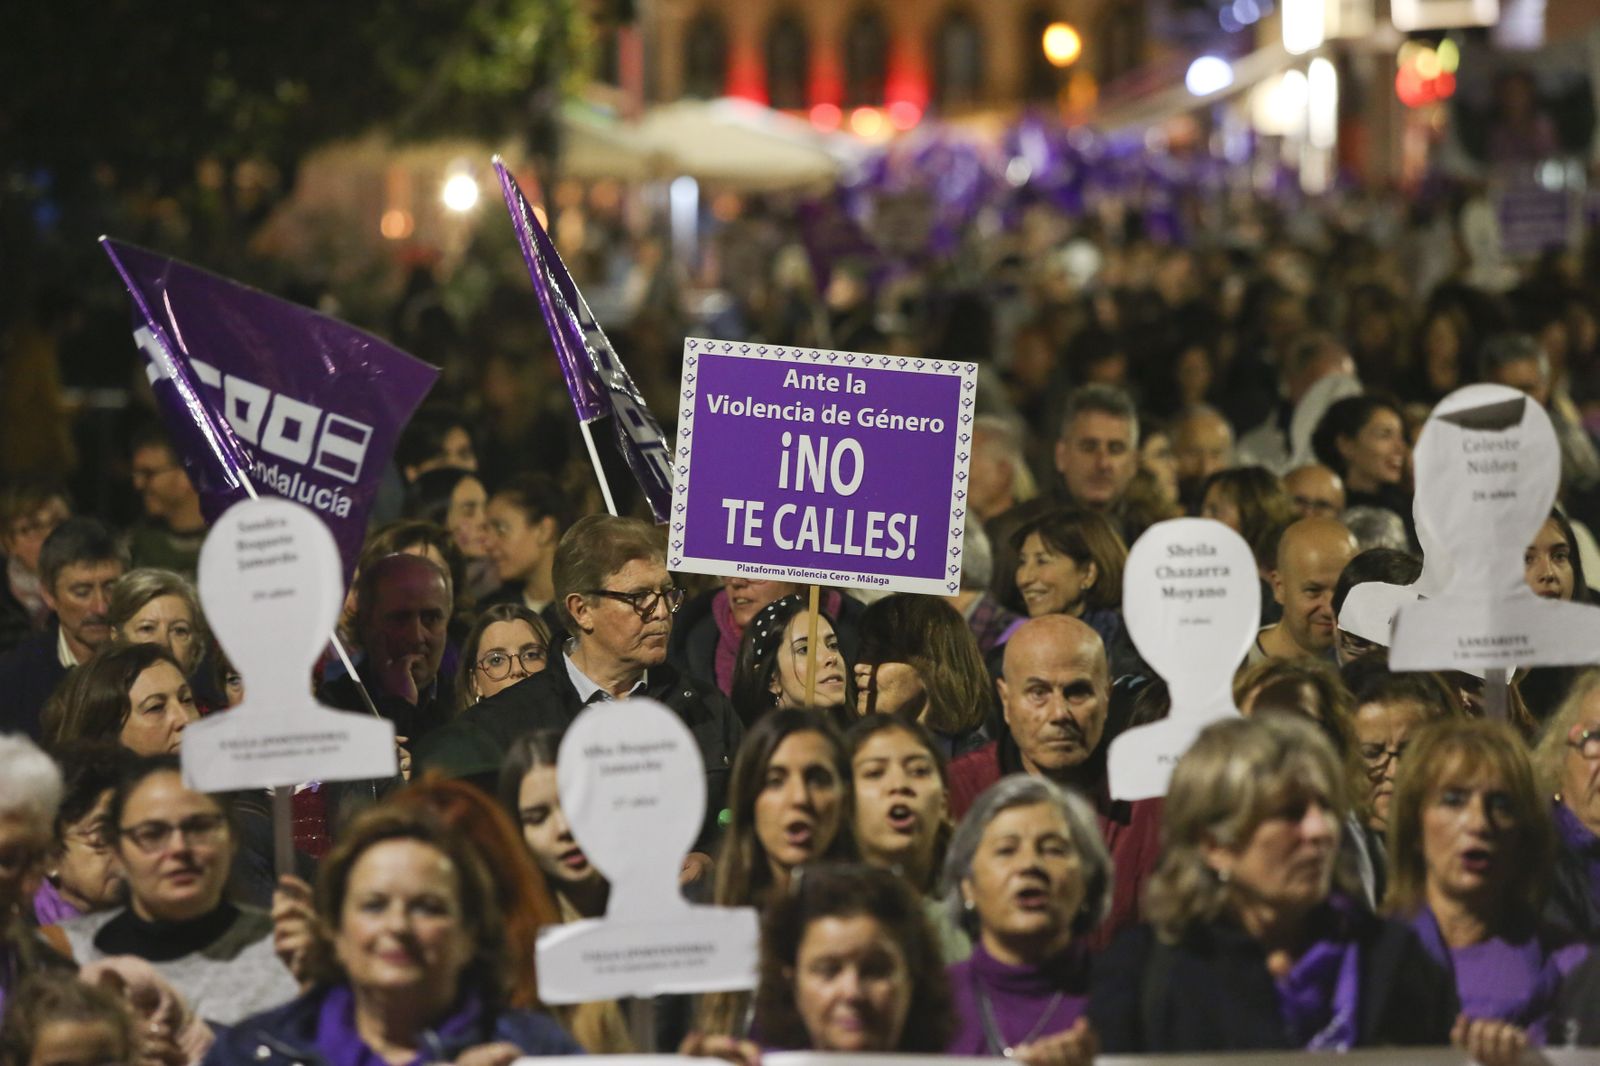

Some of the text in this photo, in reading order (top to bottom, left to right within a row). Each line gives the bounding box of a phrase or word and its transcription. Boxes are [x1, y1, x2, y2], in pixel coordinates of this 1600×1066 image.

[783, 368, 867, 395] Ante la
[706, 393, 945, 434] Violencia de Género
[778, 431, 865, 497] ¡NO
[721, 498, 918, 561] TE CALLES!
[736, 563, 786, 576] Plataforma
[787, 568, 828, 580] Violencia
[829, 573, 851, 581] Cero
[857, 574, 890, 586] Málaga
